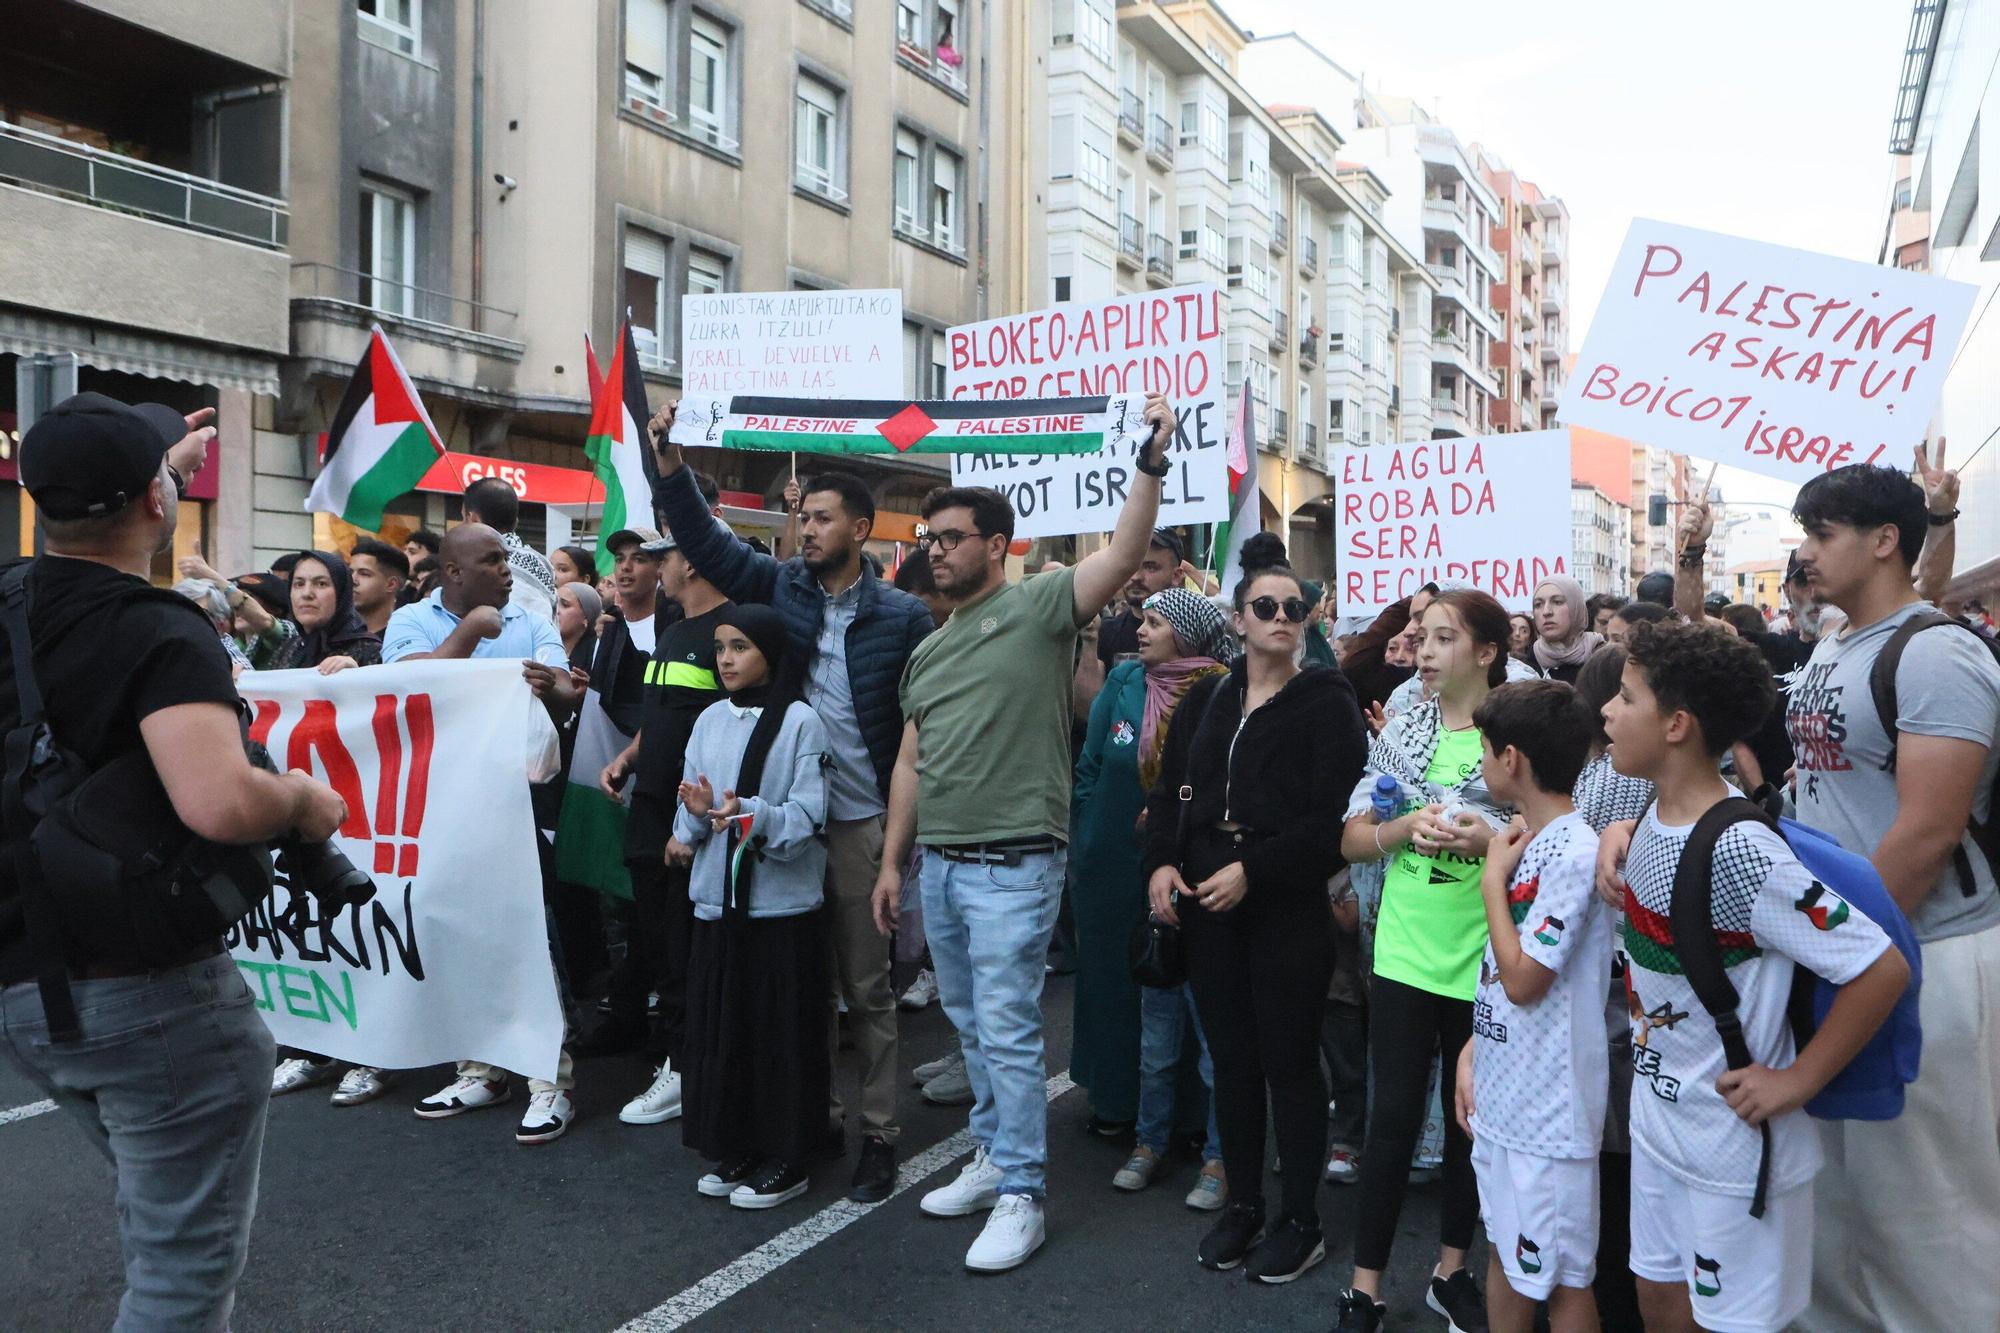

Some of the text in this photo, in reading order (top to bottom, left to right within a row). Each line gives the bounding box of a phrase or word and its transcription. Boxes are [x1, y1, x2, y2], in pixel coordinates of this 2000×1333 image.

[690, 298, 773, 317] SIONISTAK
[689, 344, 881, 368] ISRAEL DEVUELVE A
[688, 369, 837, 393] PALESTINA LAS
[743, 415, 1085, 435] PALESTINE PALESTINE
[1343, 442, 1485, 484] EL AGUA
[1075, 460, 1206, 510] ISREL
[1344, 479, 1496, 526] ROBADA
[1348, 523, 1443, 560] SERA
[1802, 661, 1839, 690] MY
